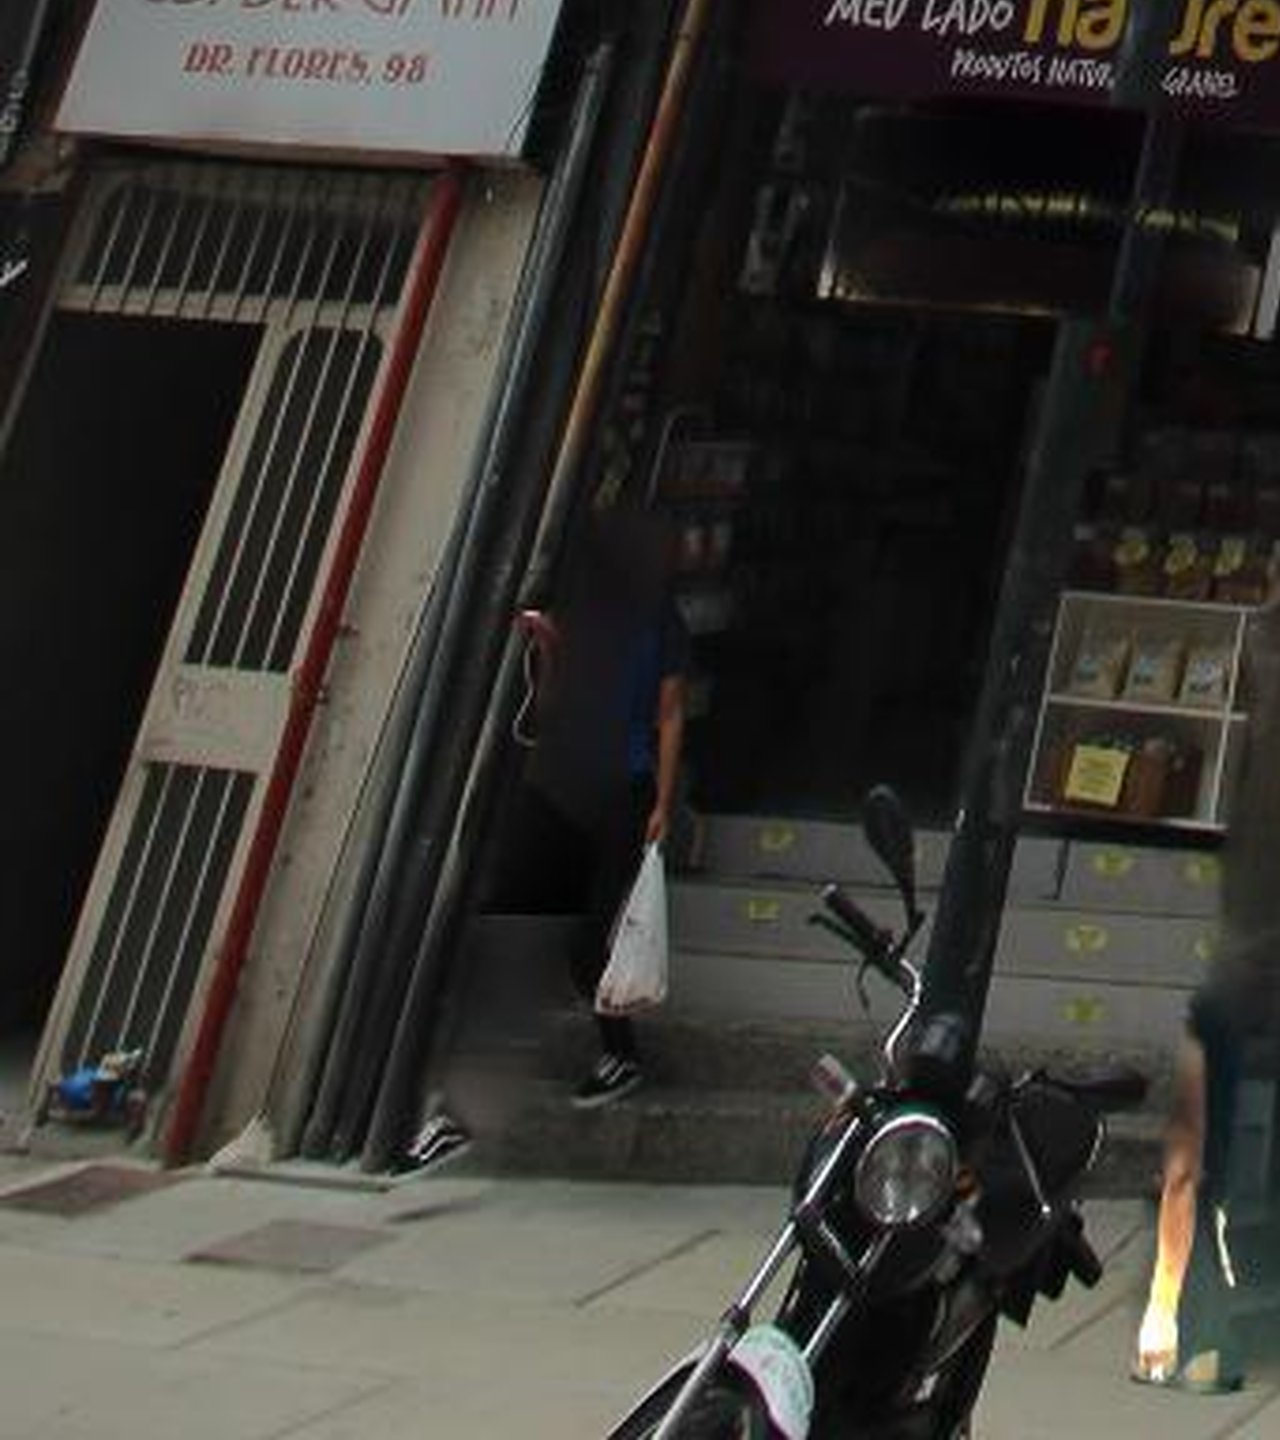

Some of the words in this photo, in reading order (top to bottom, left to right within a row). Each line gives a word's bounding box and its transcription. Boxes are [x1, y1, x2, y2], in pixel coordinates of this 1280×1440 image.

[182, 42, 234, 76] DR.
[380, 52, 430, 85] 98
[950, 47, 1042, 84] PRODUTOS
[1044, 54, 1117, 91] NATUR
[1160, 65, 1241, 100] GRANEL
